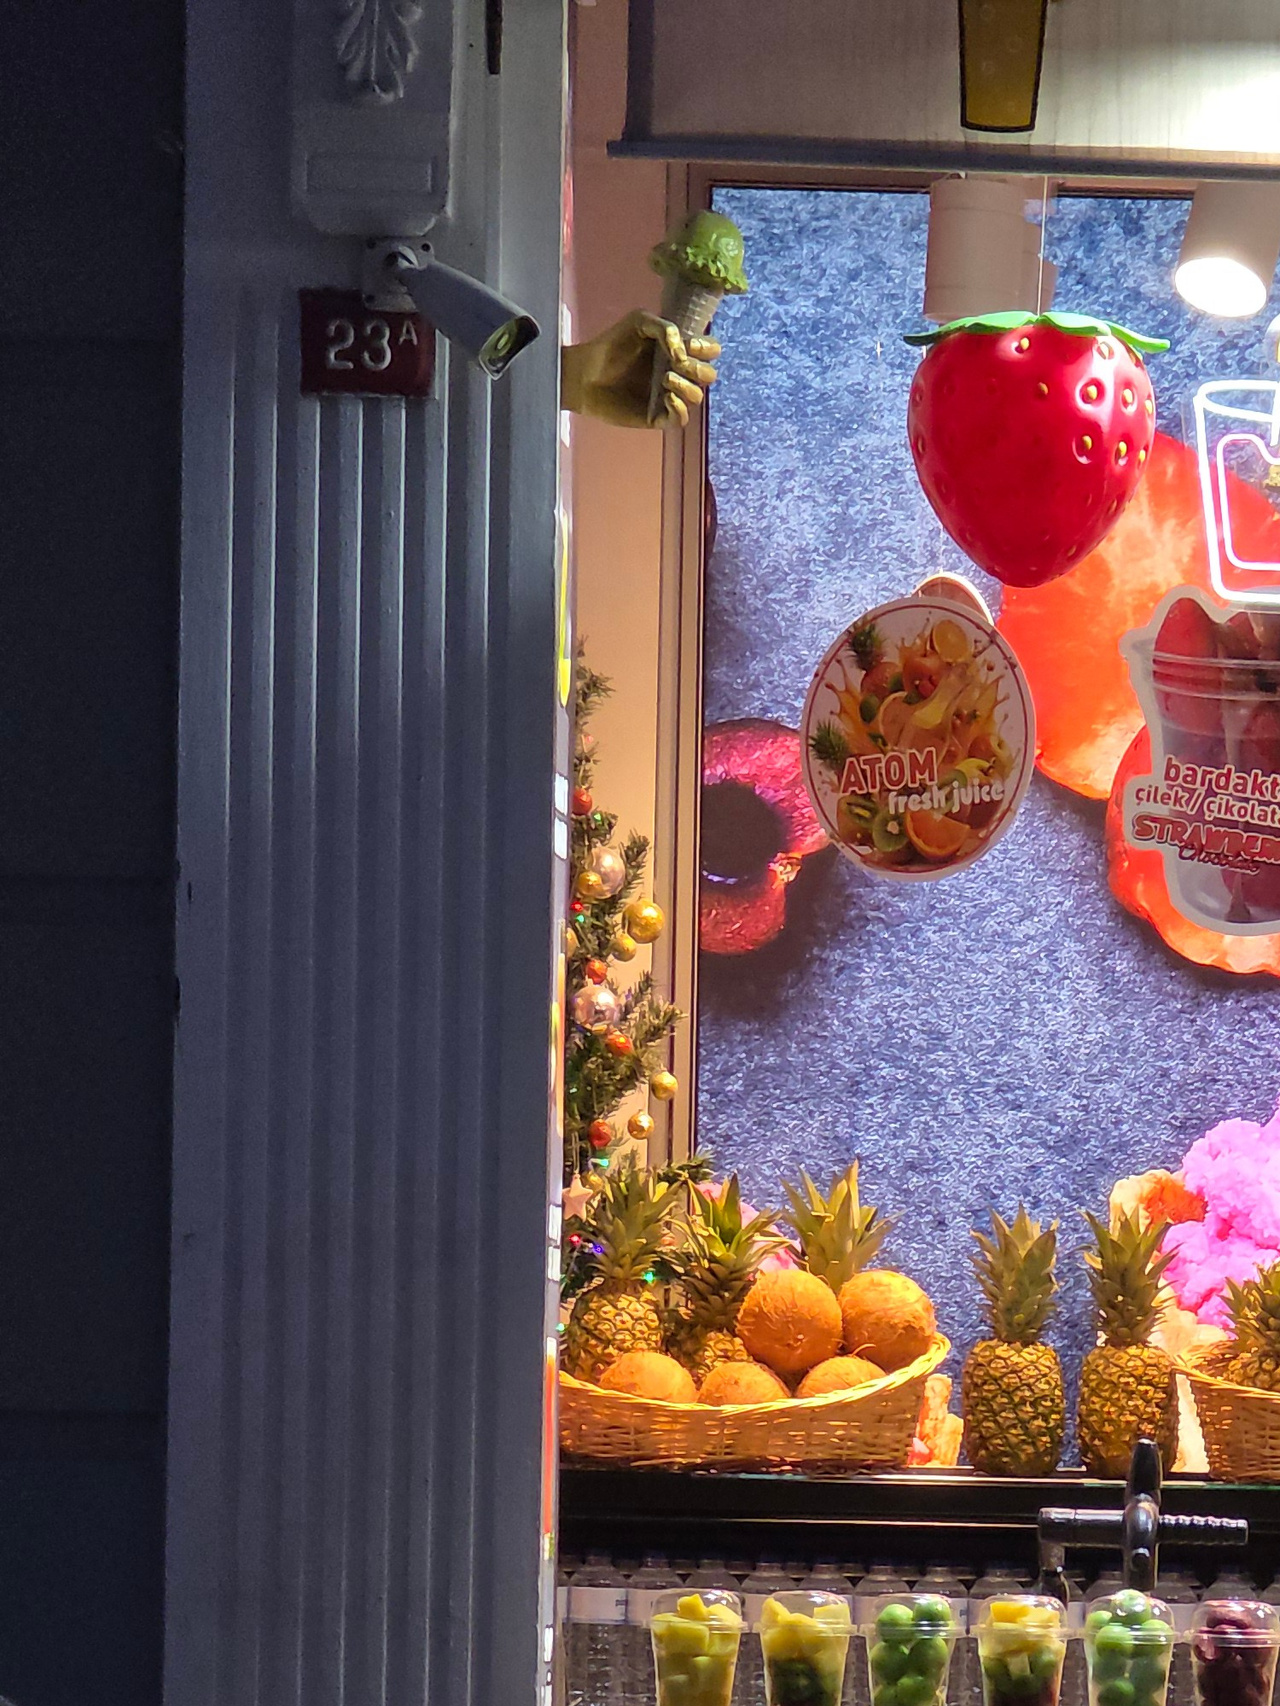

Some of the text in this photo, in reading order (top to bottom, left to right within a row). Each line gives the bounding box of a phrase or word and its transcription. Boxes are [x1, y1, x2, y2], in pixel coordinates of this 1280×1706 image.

[841, 747, 938, 795] ATOM
[888, 779, 1006, 815] fresh juice
